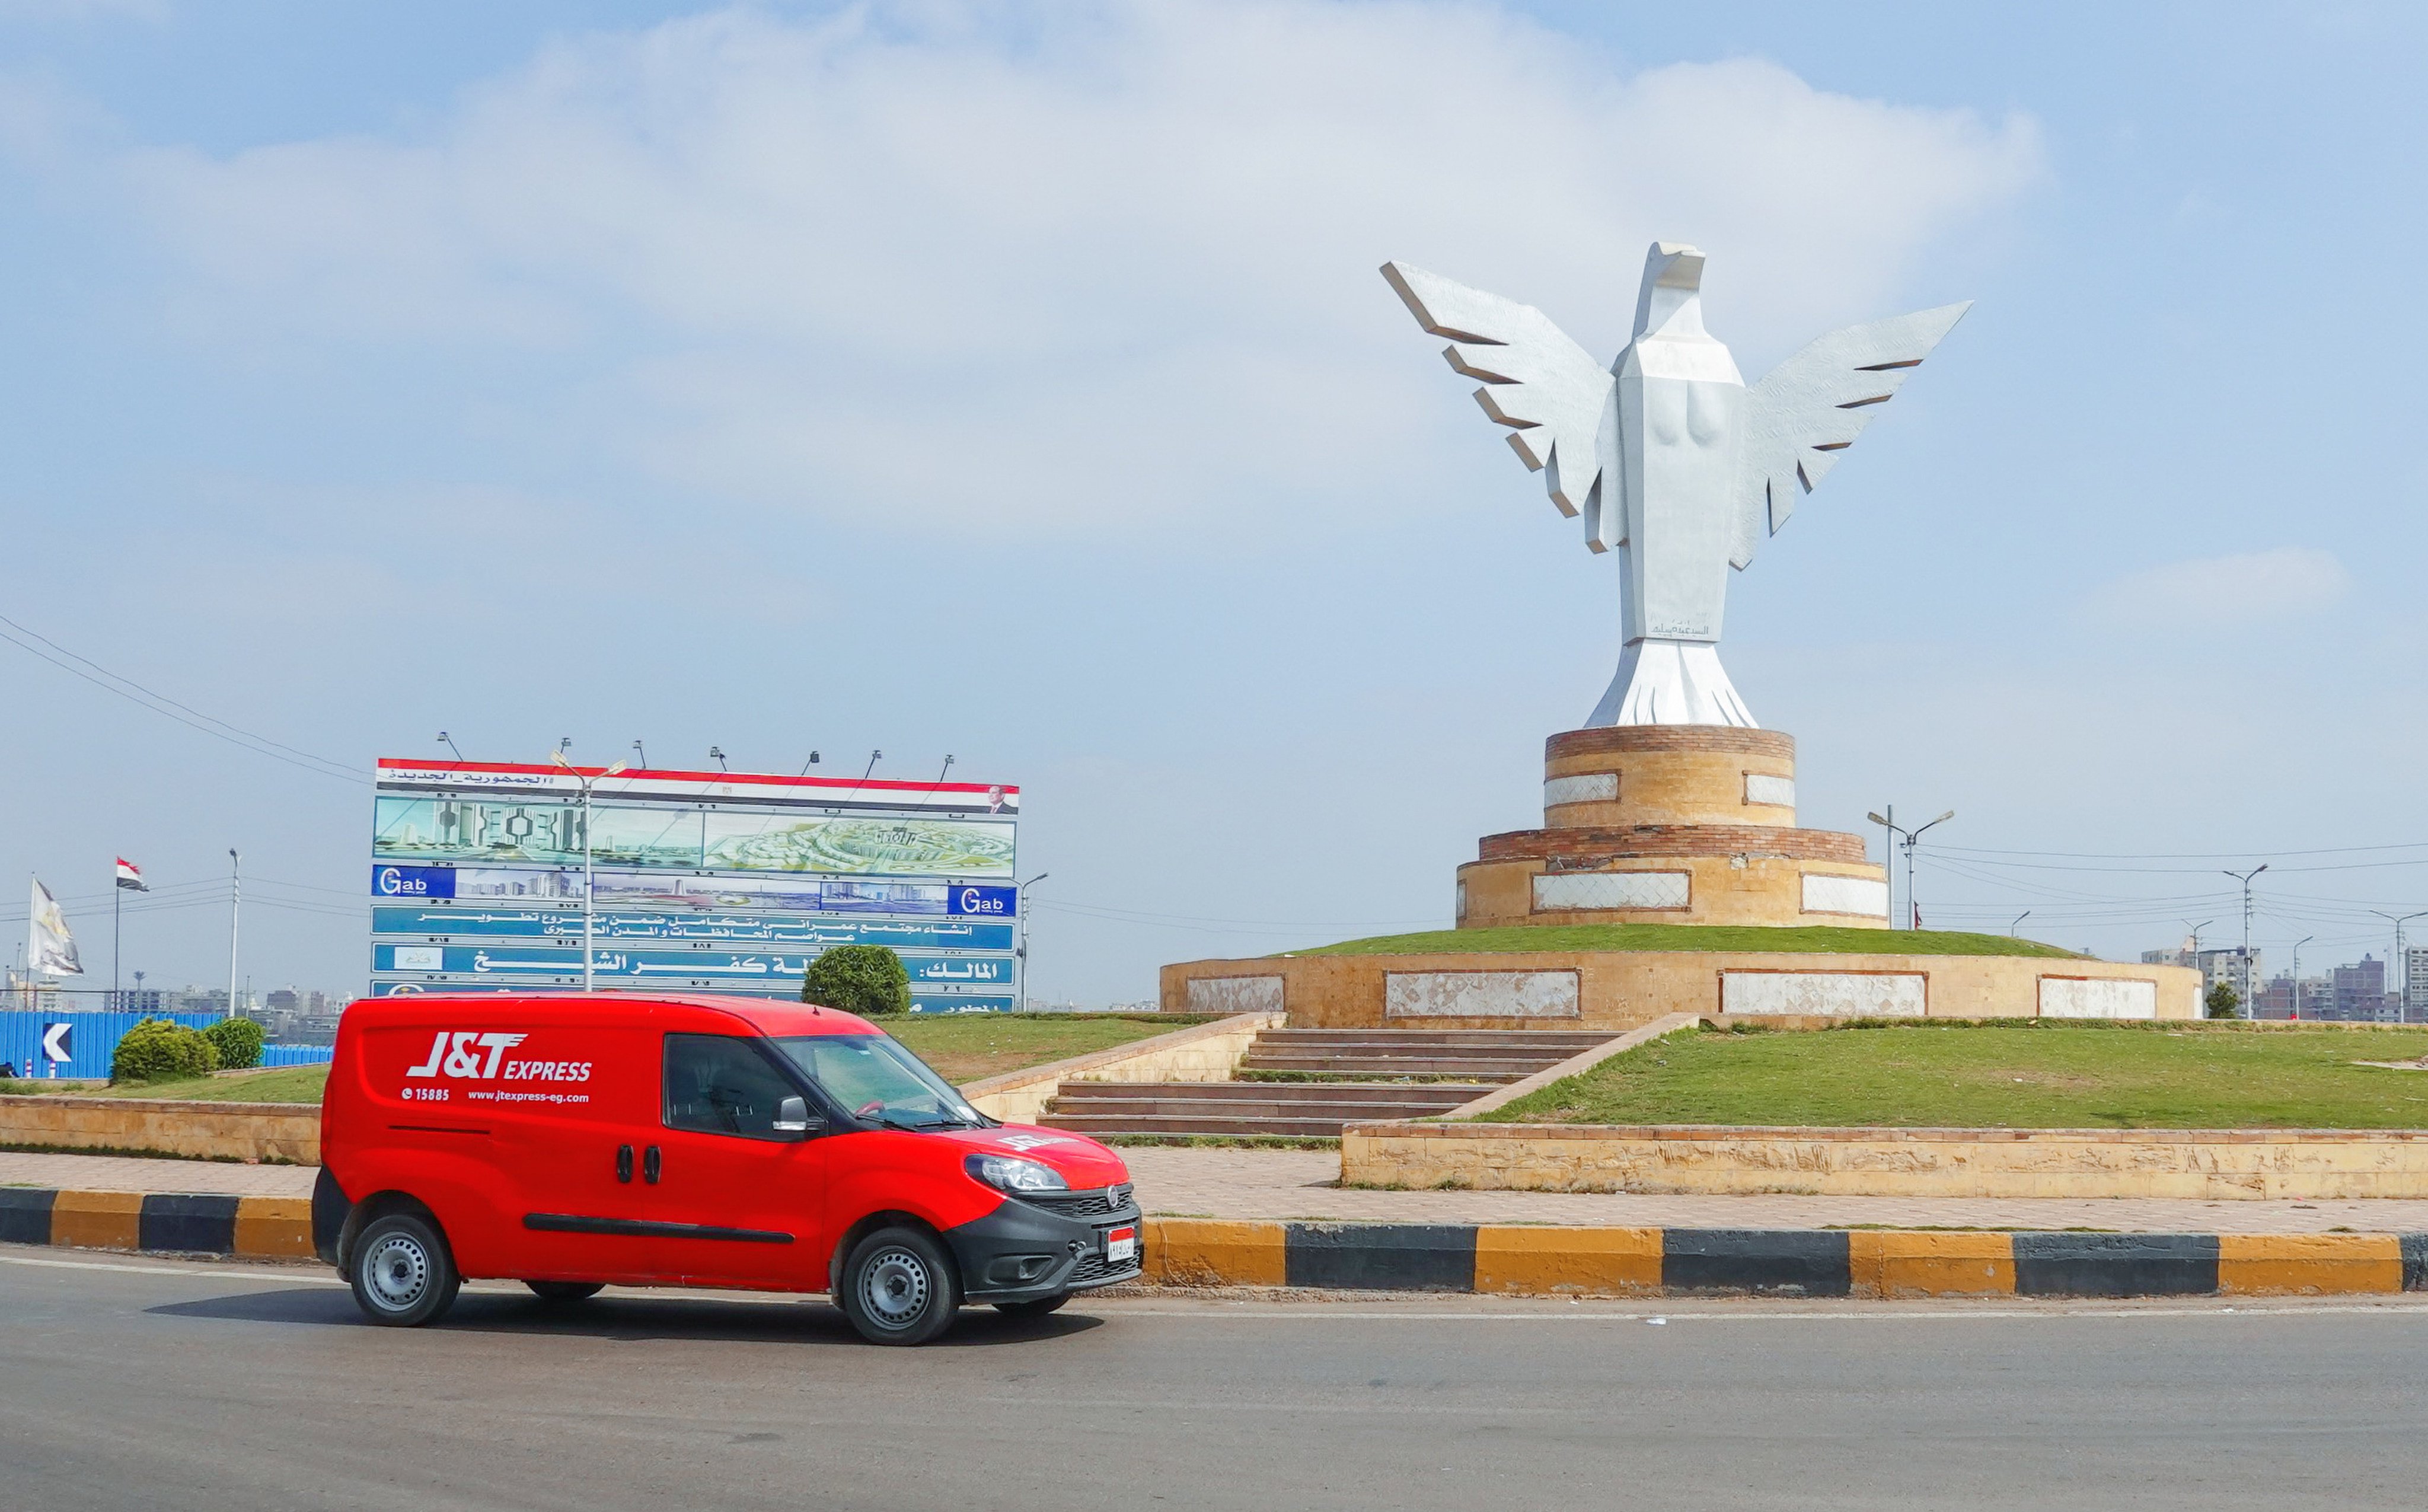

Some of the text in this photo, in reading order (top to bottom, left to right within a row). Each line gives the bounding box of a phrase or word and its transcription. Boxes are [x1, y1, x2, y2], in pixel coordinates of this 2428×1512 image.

[380, 867, 427, 894] Gab
[961, 888, 1003, 913] Gab
[417, 912, 539, 923] تطوير
[609, 916, 666, 926] ضمن
[668, 916, 761, 927] متكامل
[669, 927, 772, 939] المحافظات
[860, 923, 921, 935] مجتمع
[774, 932, 855, 943] عواصم
[630, 956, 767, 974] كفر
[406, 1032, 592, 1082] J&T EXPRESS
[416, 1089, 589, 1103] 15885 www.jtexpress-eg.com
